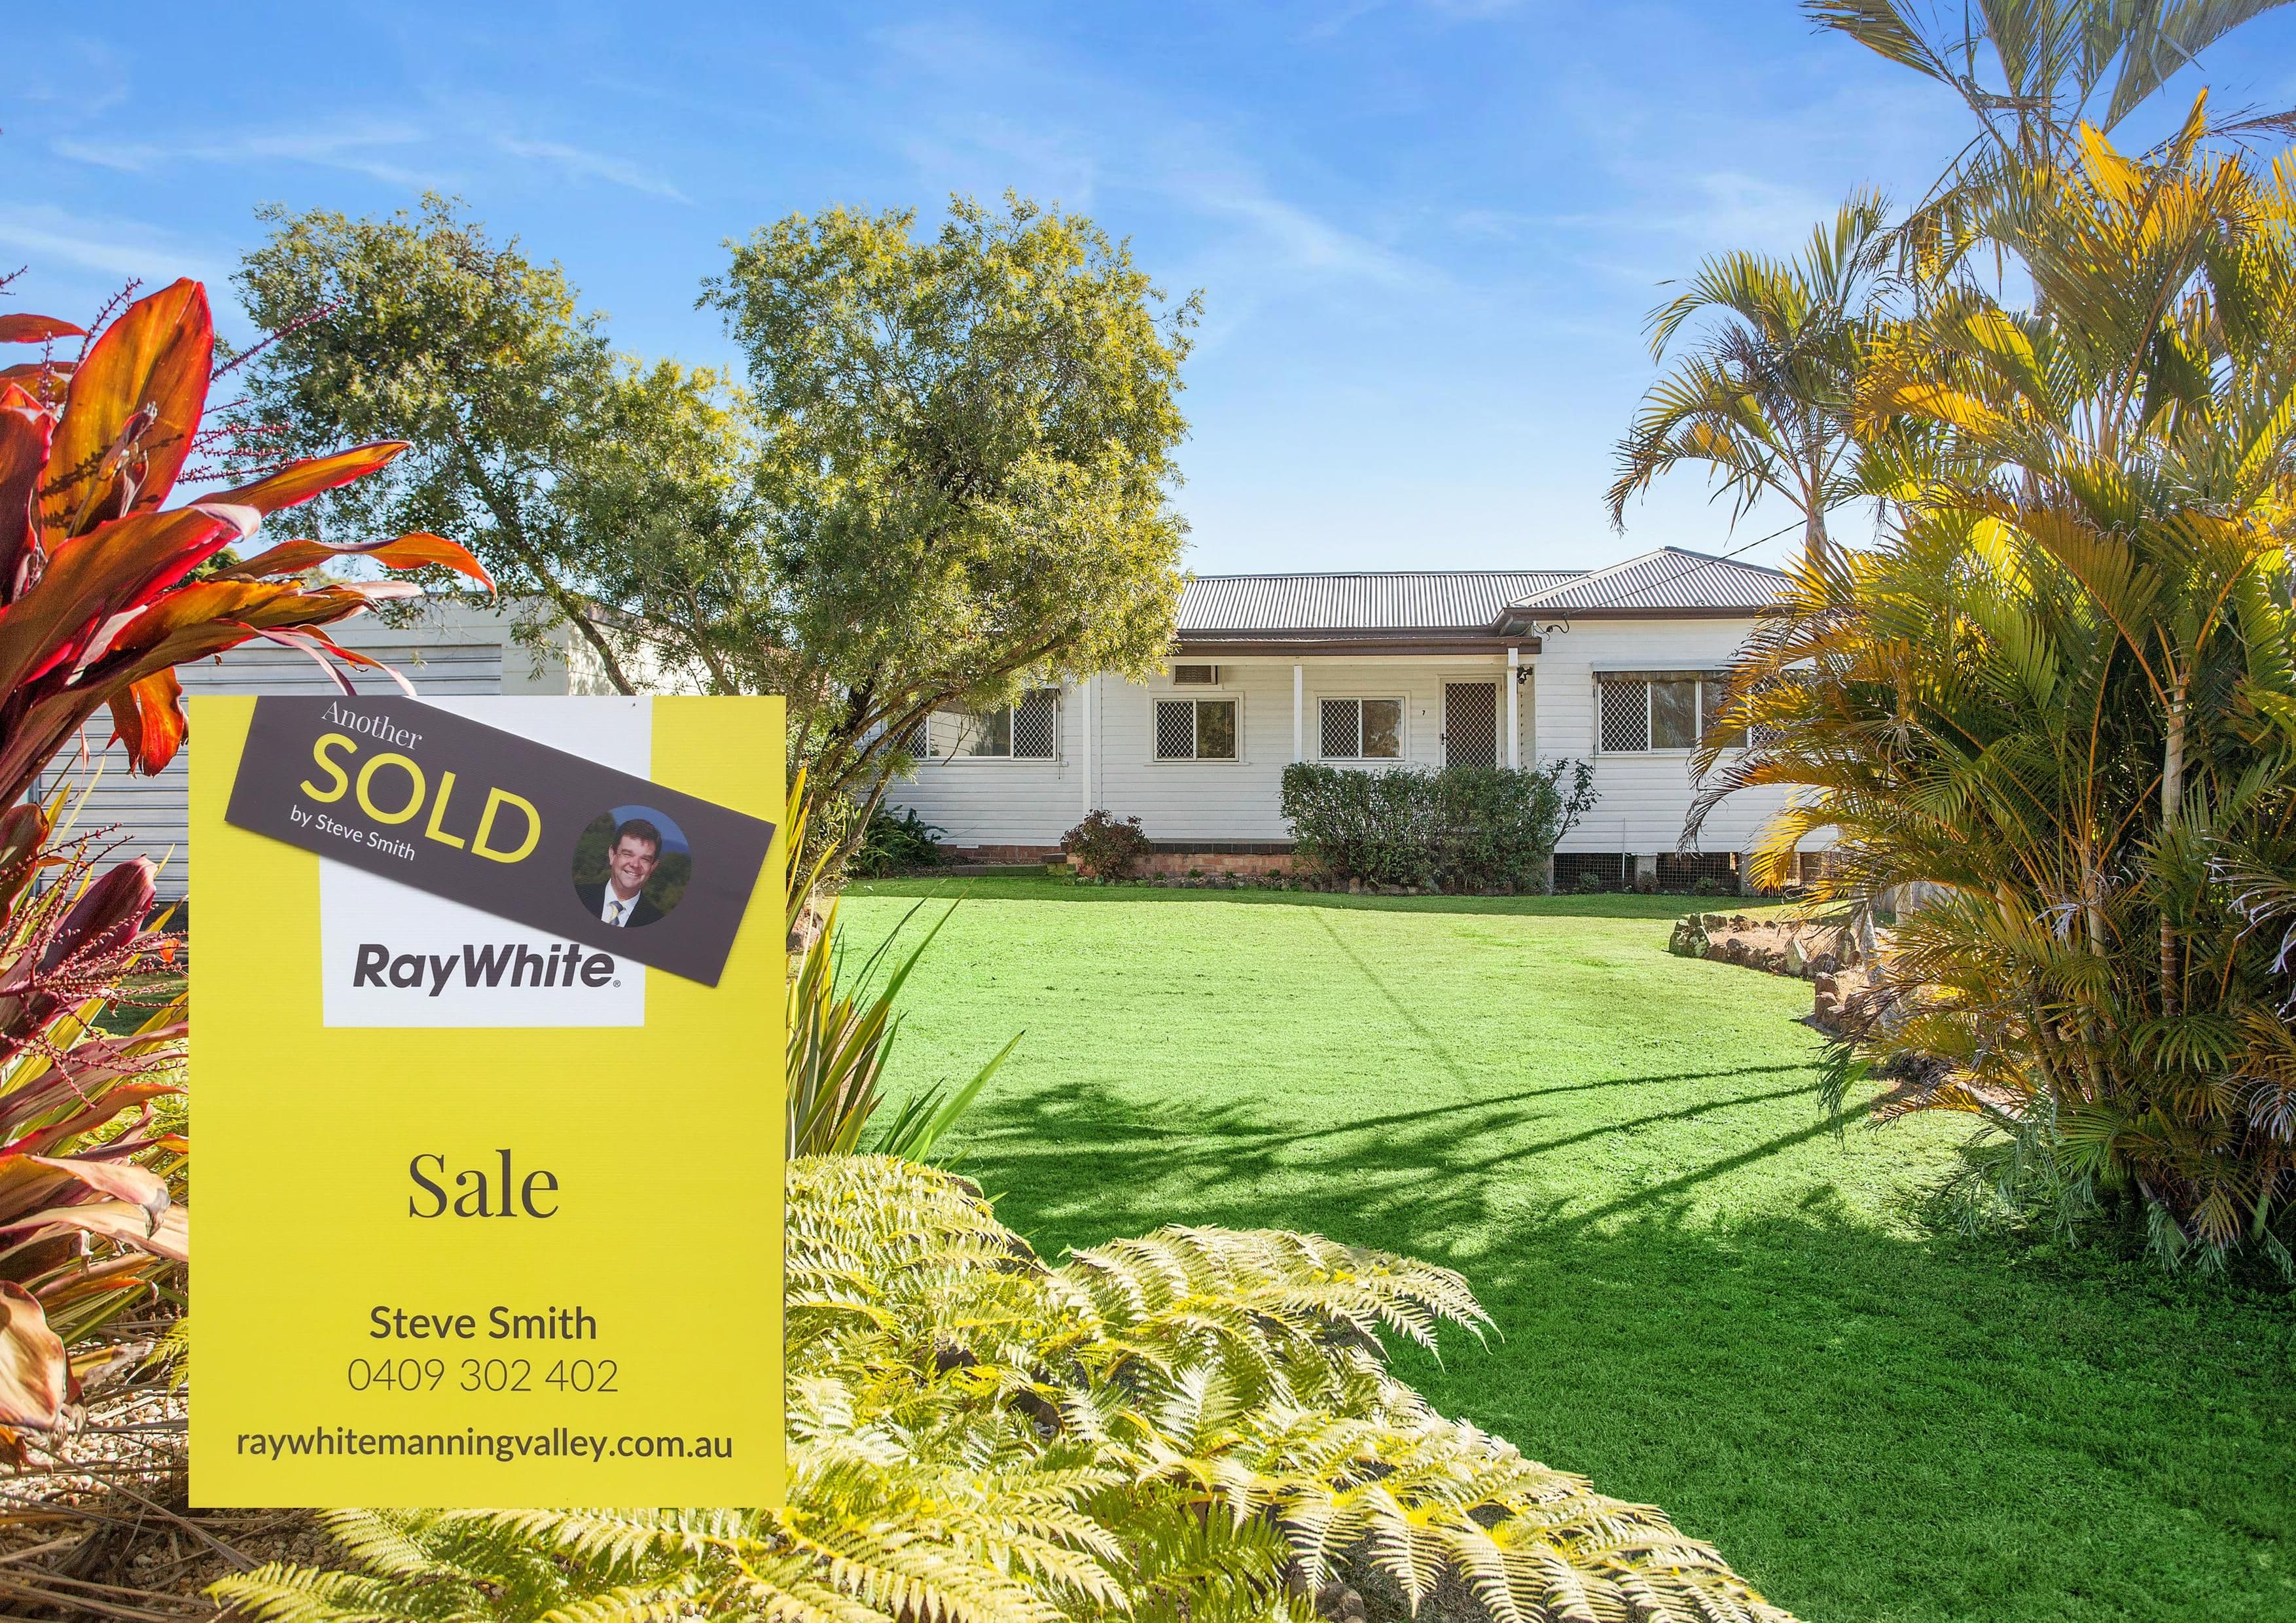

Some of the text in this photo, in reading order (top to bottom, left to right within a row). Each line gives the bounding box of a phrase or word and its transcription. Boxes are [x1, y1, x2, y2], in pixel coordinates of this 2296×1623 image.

[321, 700, 423, 751] Another
[300, 733, 542, 863] SOLD
[290, 804, 416, 861] by Steve Smith
[409, 1149, 558, 1219] Sale
[370, 1306, 596, 1340] Steve Smith
[348, 1359, 619, 1392] 0409 302 402
[238, 1426, 732, 1463] raywhitemanningvalley.com.au
